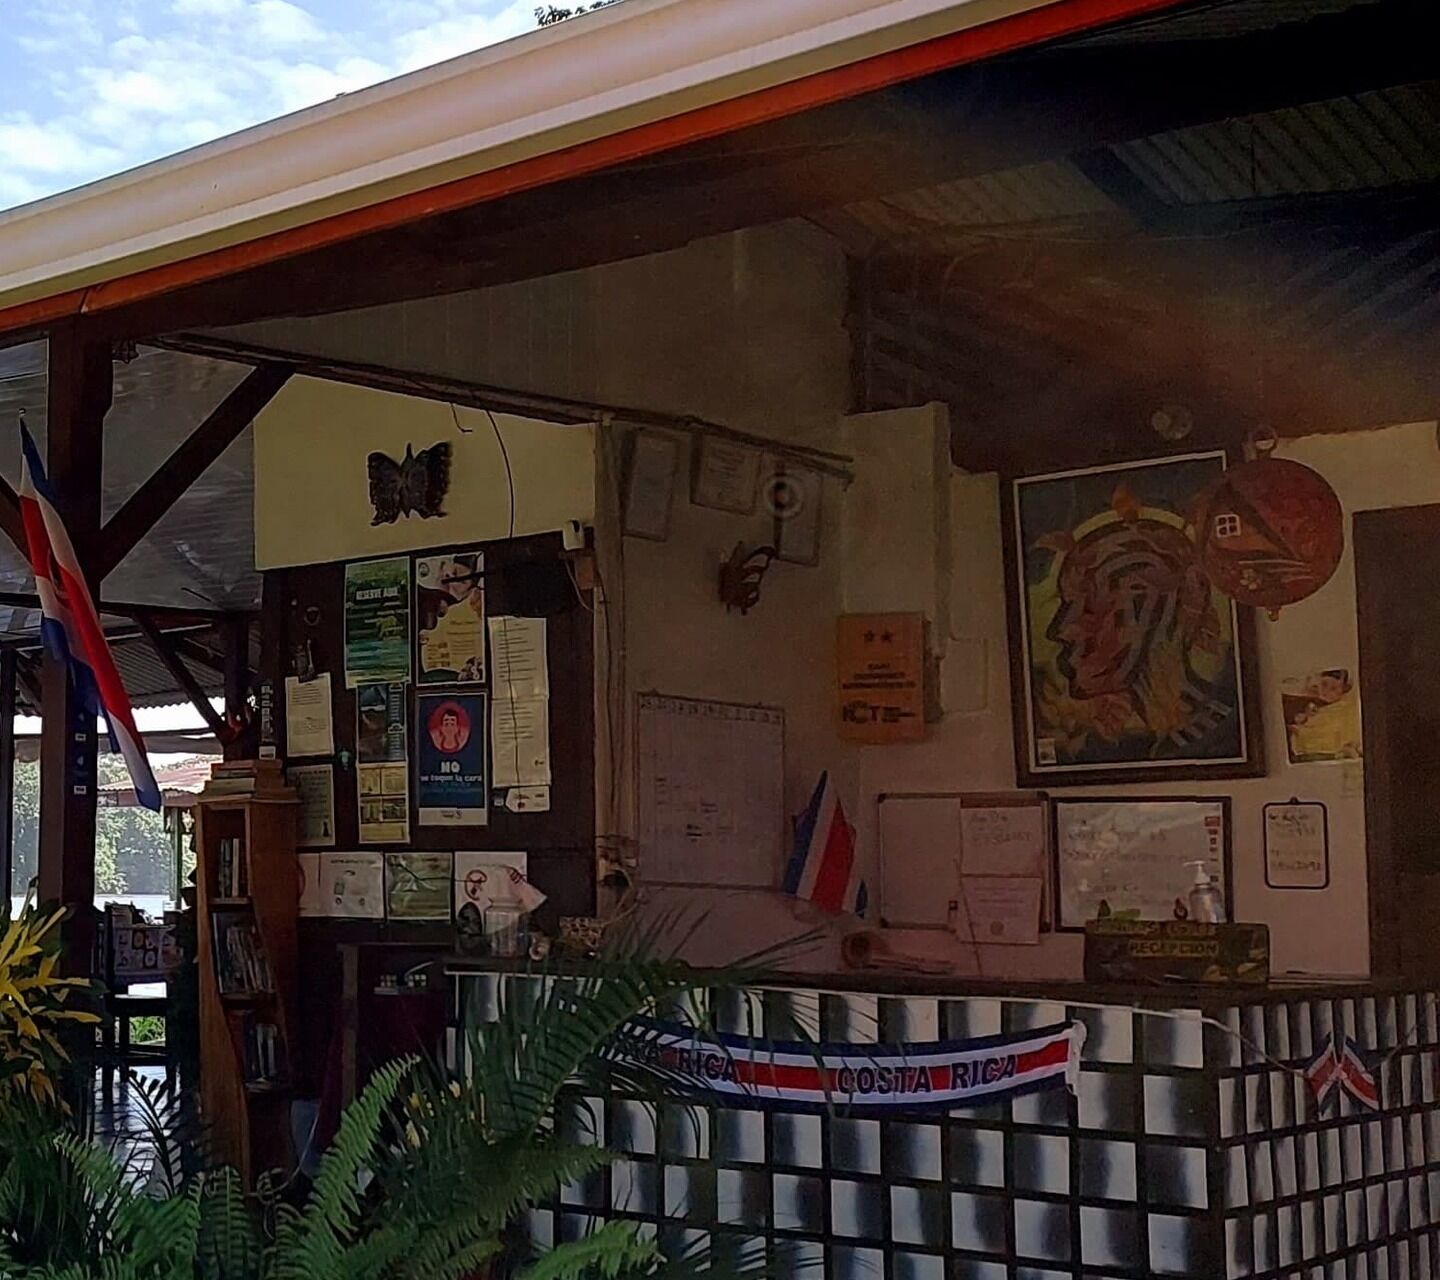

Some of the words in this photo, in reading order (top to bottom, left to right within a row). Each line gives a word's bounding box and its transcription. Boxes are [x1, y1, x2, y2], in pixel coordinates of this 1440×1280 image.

[441, 761, 460, 773] NO
[838, 1066, 931, 1094] COSTA
[951, 1055, 1017, 1090] RICA
